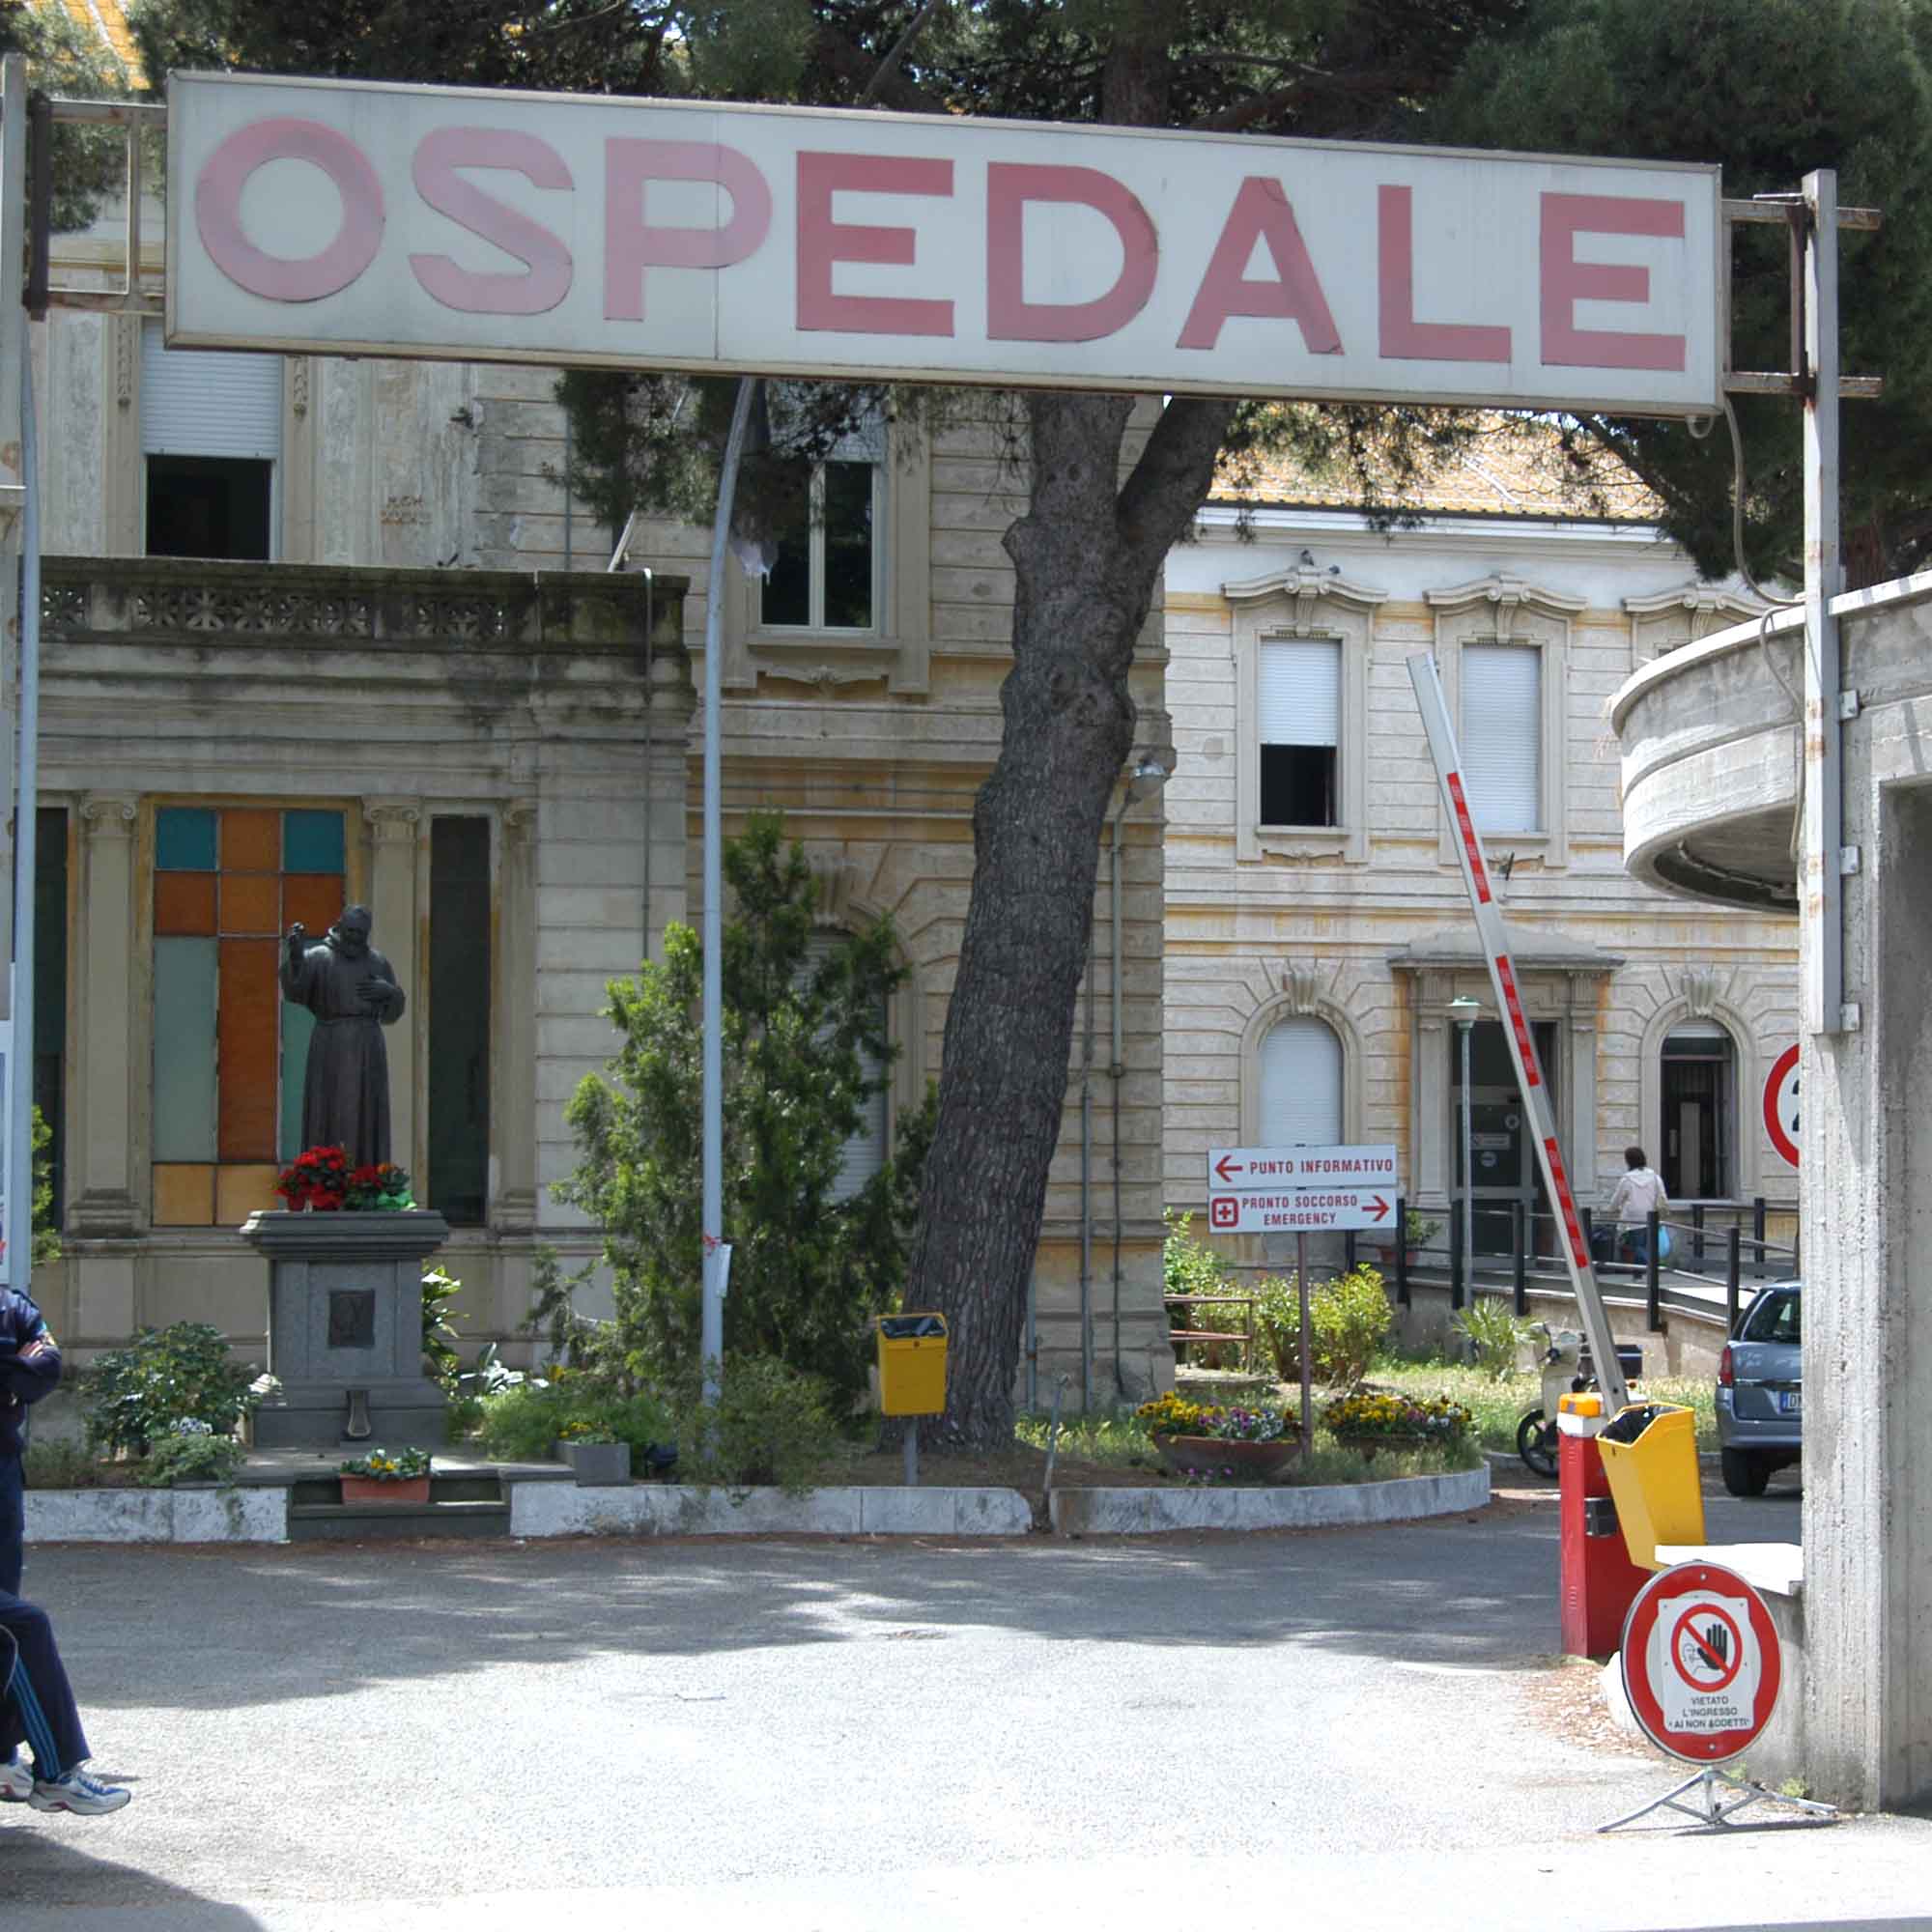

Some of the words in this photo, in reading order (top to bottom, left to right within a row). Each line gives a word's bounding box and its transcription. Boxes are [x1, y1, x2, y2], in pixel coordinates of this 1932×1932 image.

[196, 116, 1686, 371] OSPEDALE
[1250, 1161, 1294, 1175] PUNTO
[1300, 1158, 1393, 1173] INFORMATIVO
[1242, 1197, 1290, 1208] PRONTO
[1294, 1195, 1358, 1207] SOCCORSO
[1264, 1212, 1336, 1225] EMERGENCY
[1690, 1695, 1729, 1705] VIETATO
[1682, 1707, 1738, 1718] L'INGRESSO
[1686, 1719, 1706, 1728] NON
